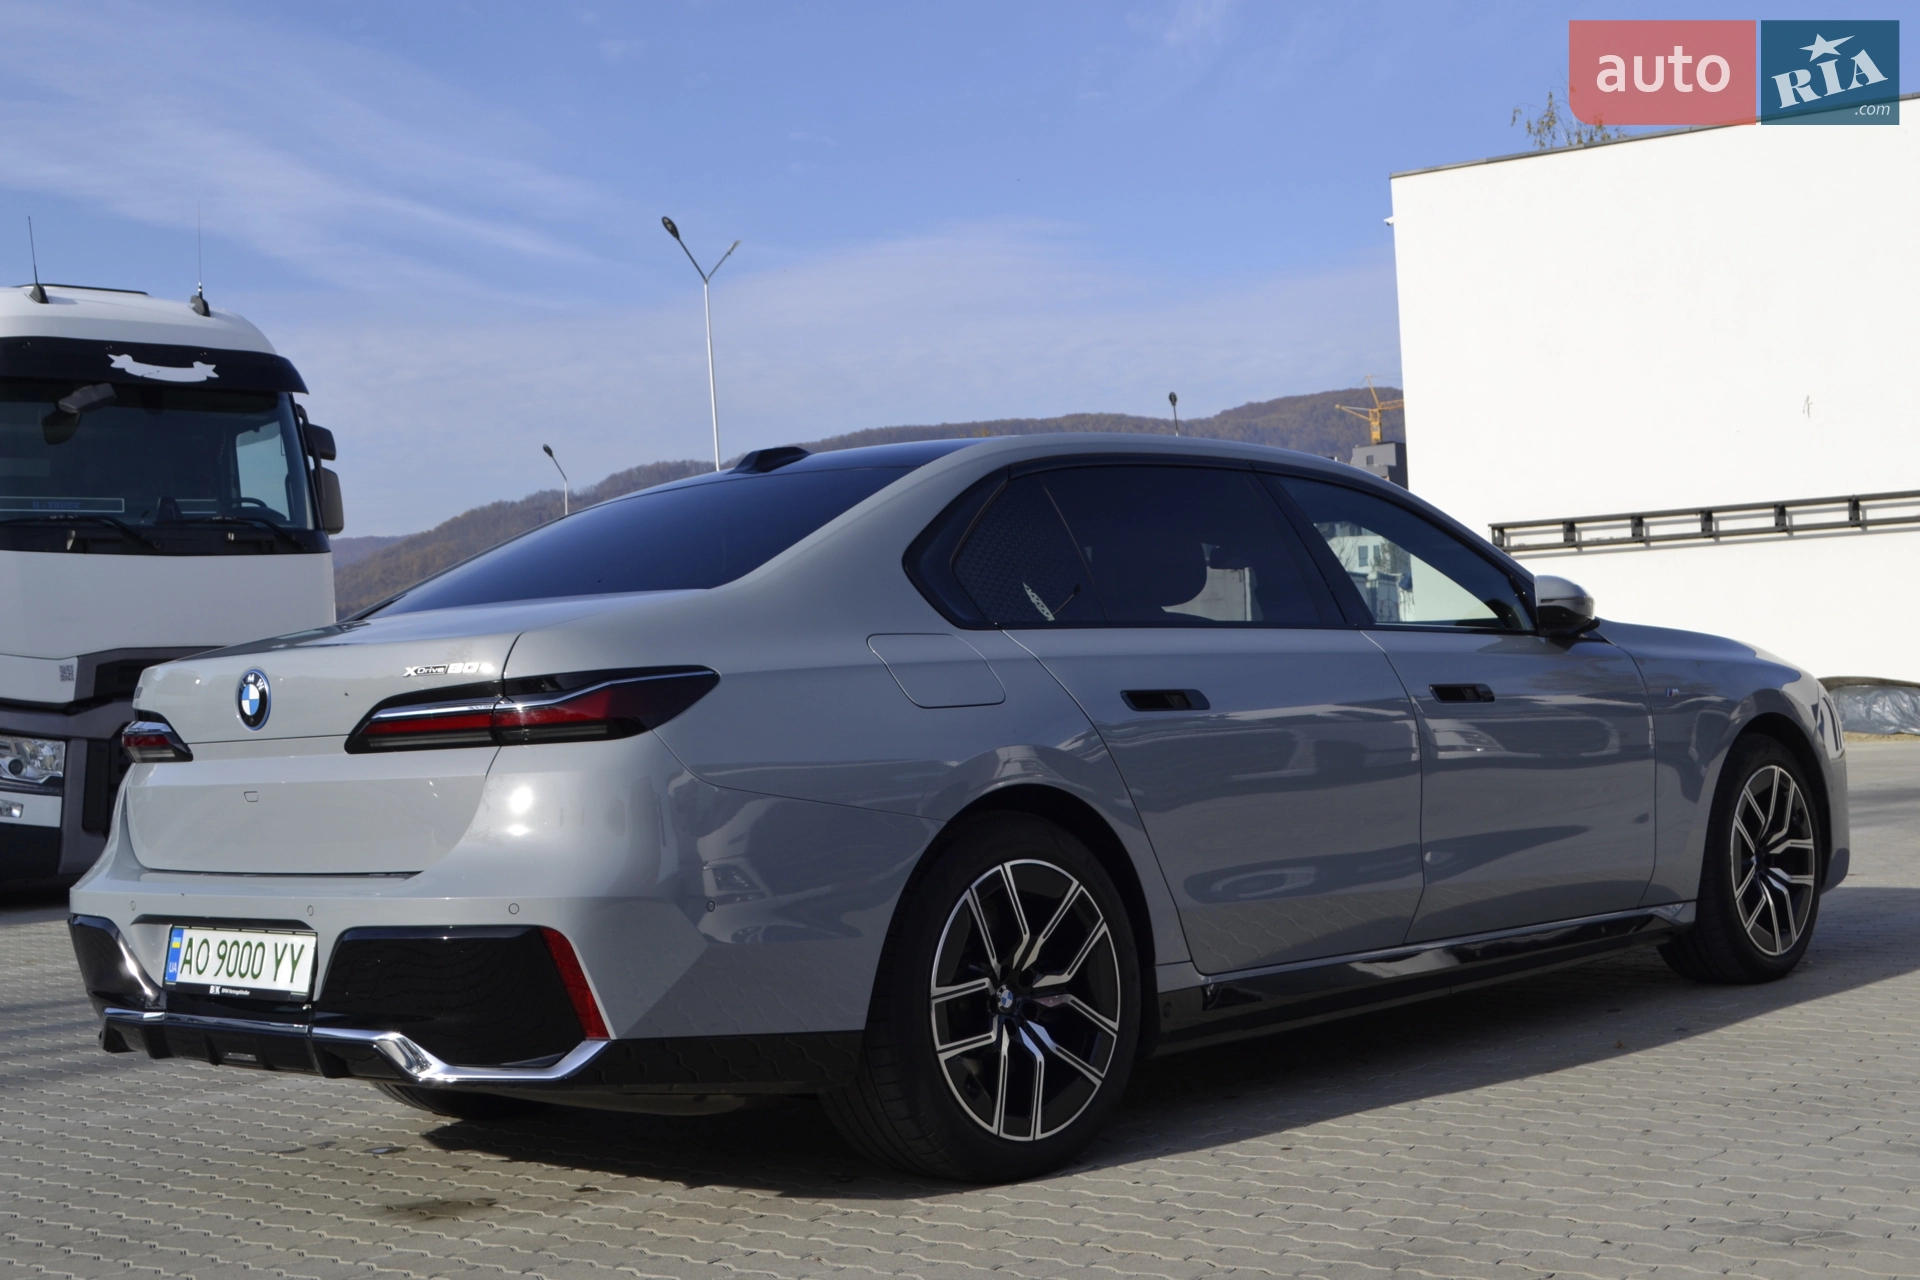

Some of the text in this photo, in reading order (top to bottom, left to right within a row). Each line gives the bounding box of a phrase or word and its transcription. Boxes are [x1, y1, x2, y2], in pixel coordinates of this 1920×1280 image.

[169, 961, 177, 973] UA
[180, 937, 305, 983] AO 9000 YY
